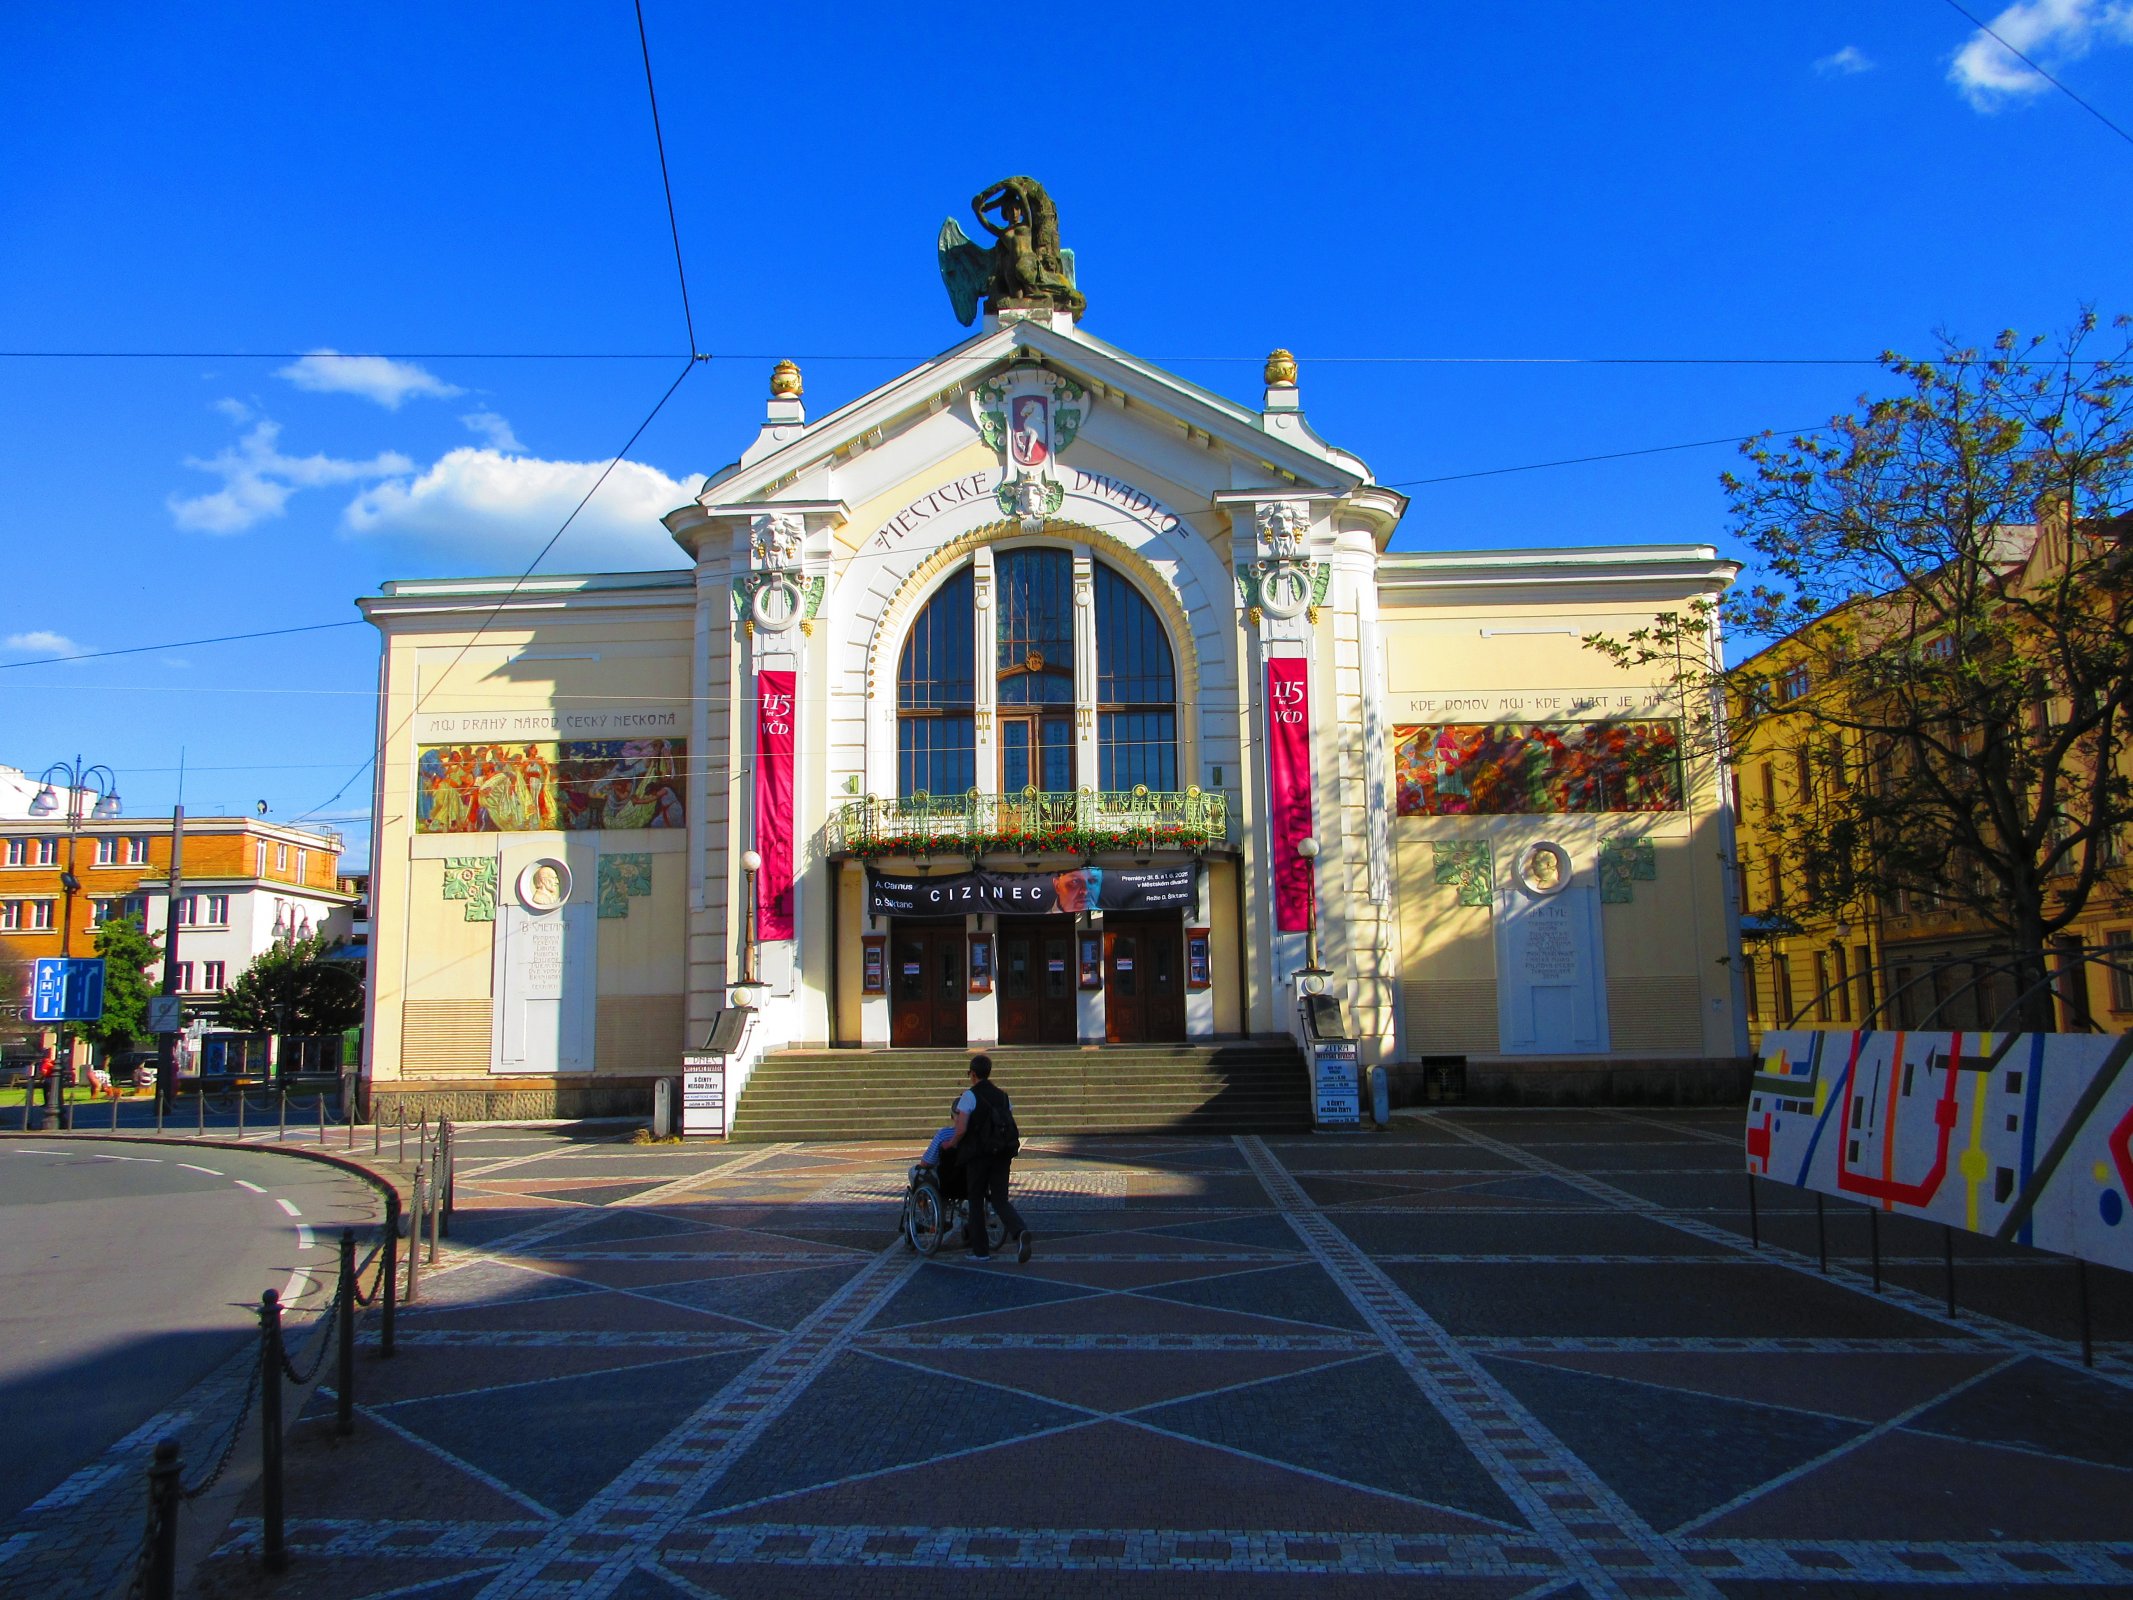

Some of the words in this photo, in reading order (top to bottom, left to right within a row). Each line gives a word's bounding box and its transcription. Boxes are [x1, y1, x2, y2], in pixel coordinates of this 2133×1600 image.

[1073, 470, 1181, 533] DIVADLO
[1273, 681, 1304, 705] 115
[762, 693, 792, 717] 115
[1410, 700, 1436, 711] KDE
[1445, 699, 1489, 711] DOMOV
[1535, 697, 1560, 708] KDE
[1617, 696, 1633, 707] JE
[463, 717, 507, 730] DRAHÝ
[514, 716, 558, 729] NÁROD
[1274, 709, 1303, 724] VČD
[762, 720, 789, 735] VČD
[875, 881, 883, 889] A.
[884, 881, 913, 891] Camus
[930, 886, 1042, 902] CIZINEC
[875, 898, 883, 906] D.
